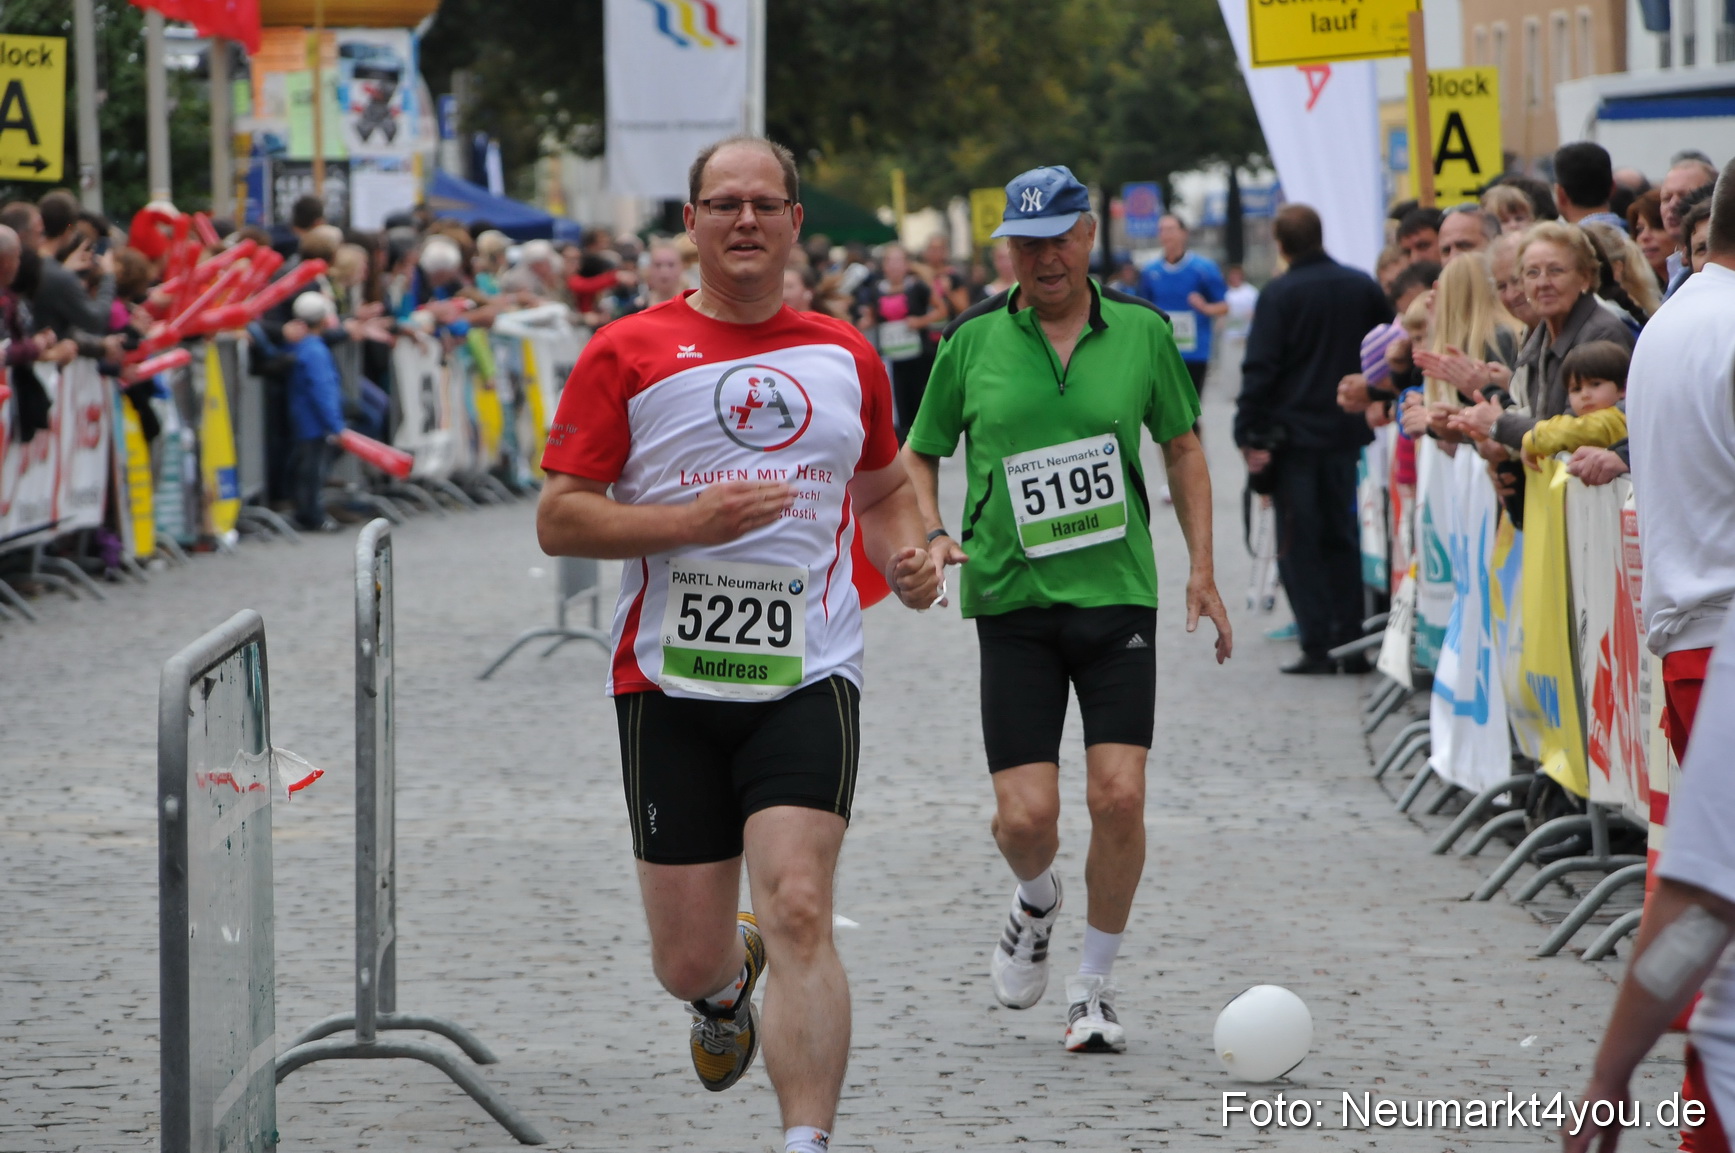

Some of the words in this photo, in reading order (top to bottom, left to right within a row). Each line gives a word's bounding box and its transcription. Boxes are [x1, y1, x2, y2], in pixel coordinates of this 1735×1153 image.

[1311, 8, 1357, 33] lauf
[0, 40, 53, 67] lock
[0, 79, 40, 146] A
[1433, 111, 1481, 175] A
[1007, 460, 1044, 476] PARTL
[1046, 448, 1100, 467] Neumarkt
[1021, 461, 1114, 516] 5195
[1051, 513, 1099, 538] Harald
[672, 571, 713, 586] PARTL
[717, 575, 783, 592] Neumarkt
[677, 592, 792, 648] 5229
[692, 655, 768, 680] Andreas
